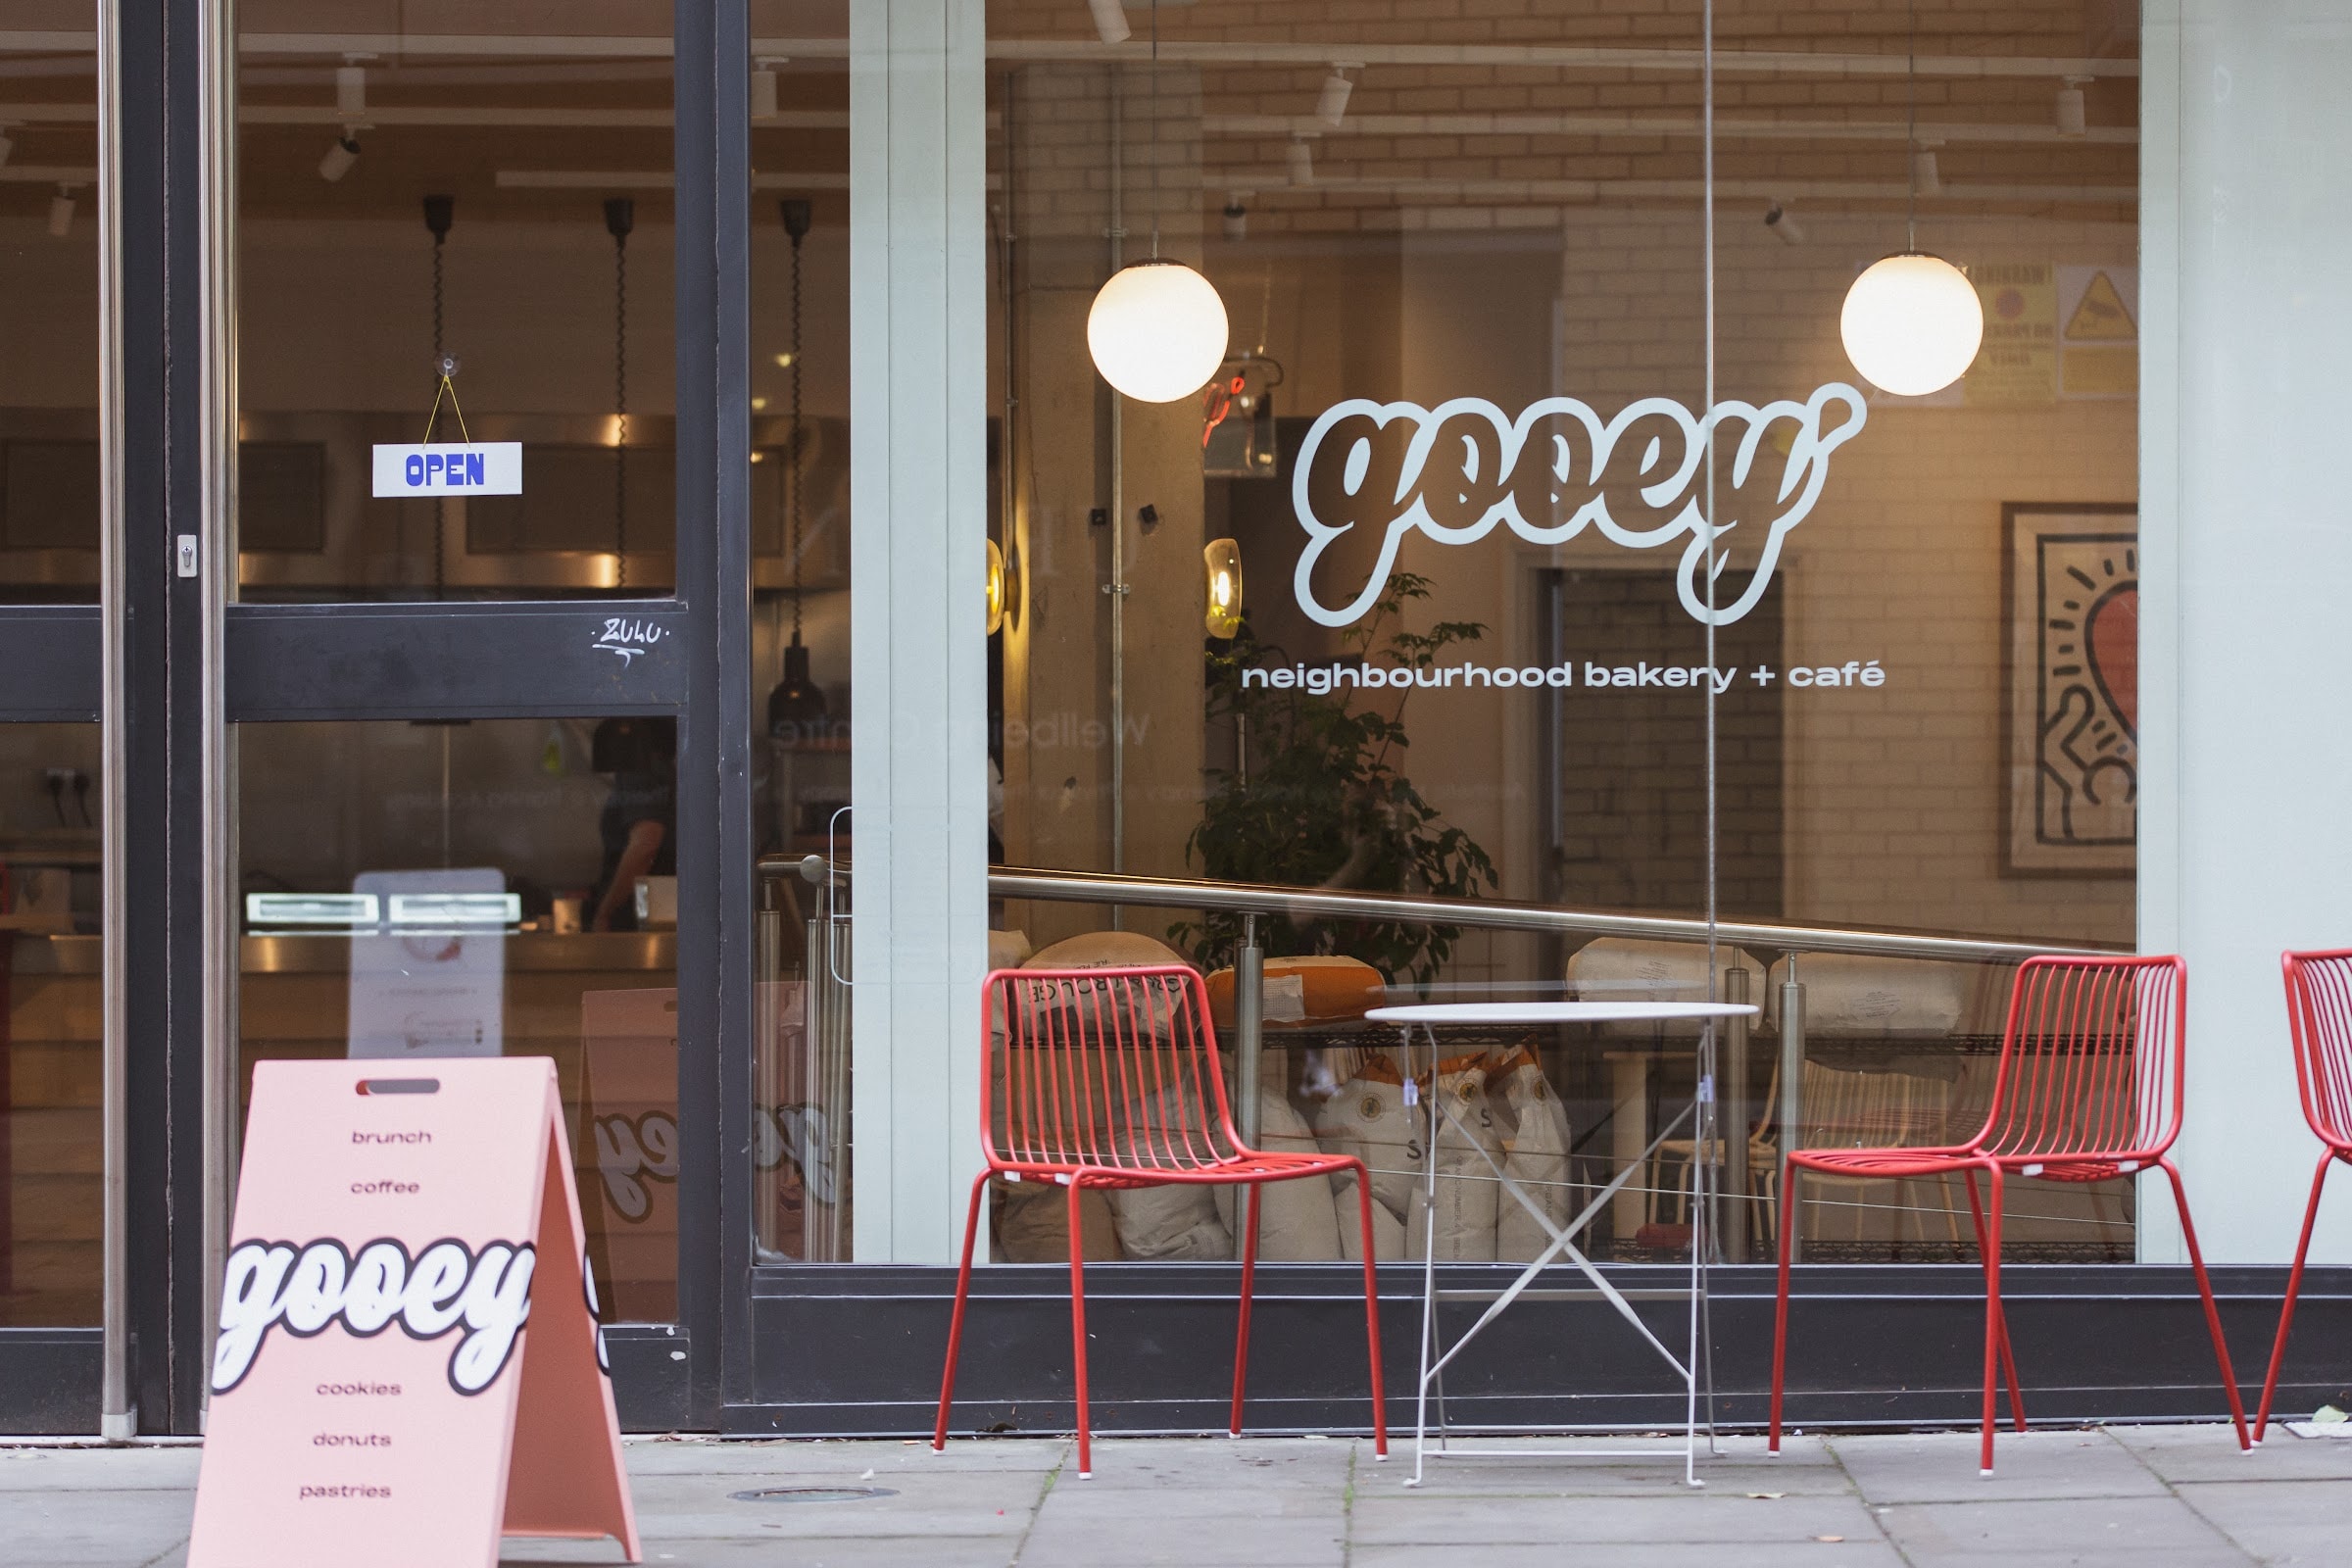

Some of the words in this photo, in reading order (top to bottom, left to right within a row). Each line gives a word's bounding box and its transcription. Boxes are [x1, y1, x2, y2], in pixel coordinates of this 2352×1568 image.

[406, 454, 484, 486] OPEN
[1293, 382, 1868, 627] gooey
[1242, 662, 1571, 695] neighbourhood
[1585, 662, 1737, 694] bakery
[1749, 666, 1776, 687] +
[1788, 659, 1886, 687] café
[351, 1129, 433, 1146] brunch
[350, 1179, 421, 1195] coffee
[210, 1237, 536, 1396] gooey
[316, 1380, 403, 1396] cookies
[312, 1431, 393, 1447] donuts
[299, 1483, 393, 1500] pastries
